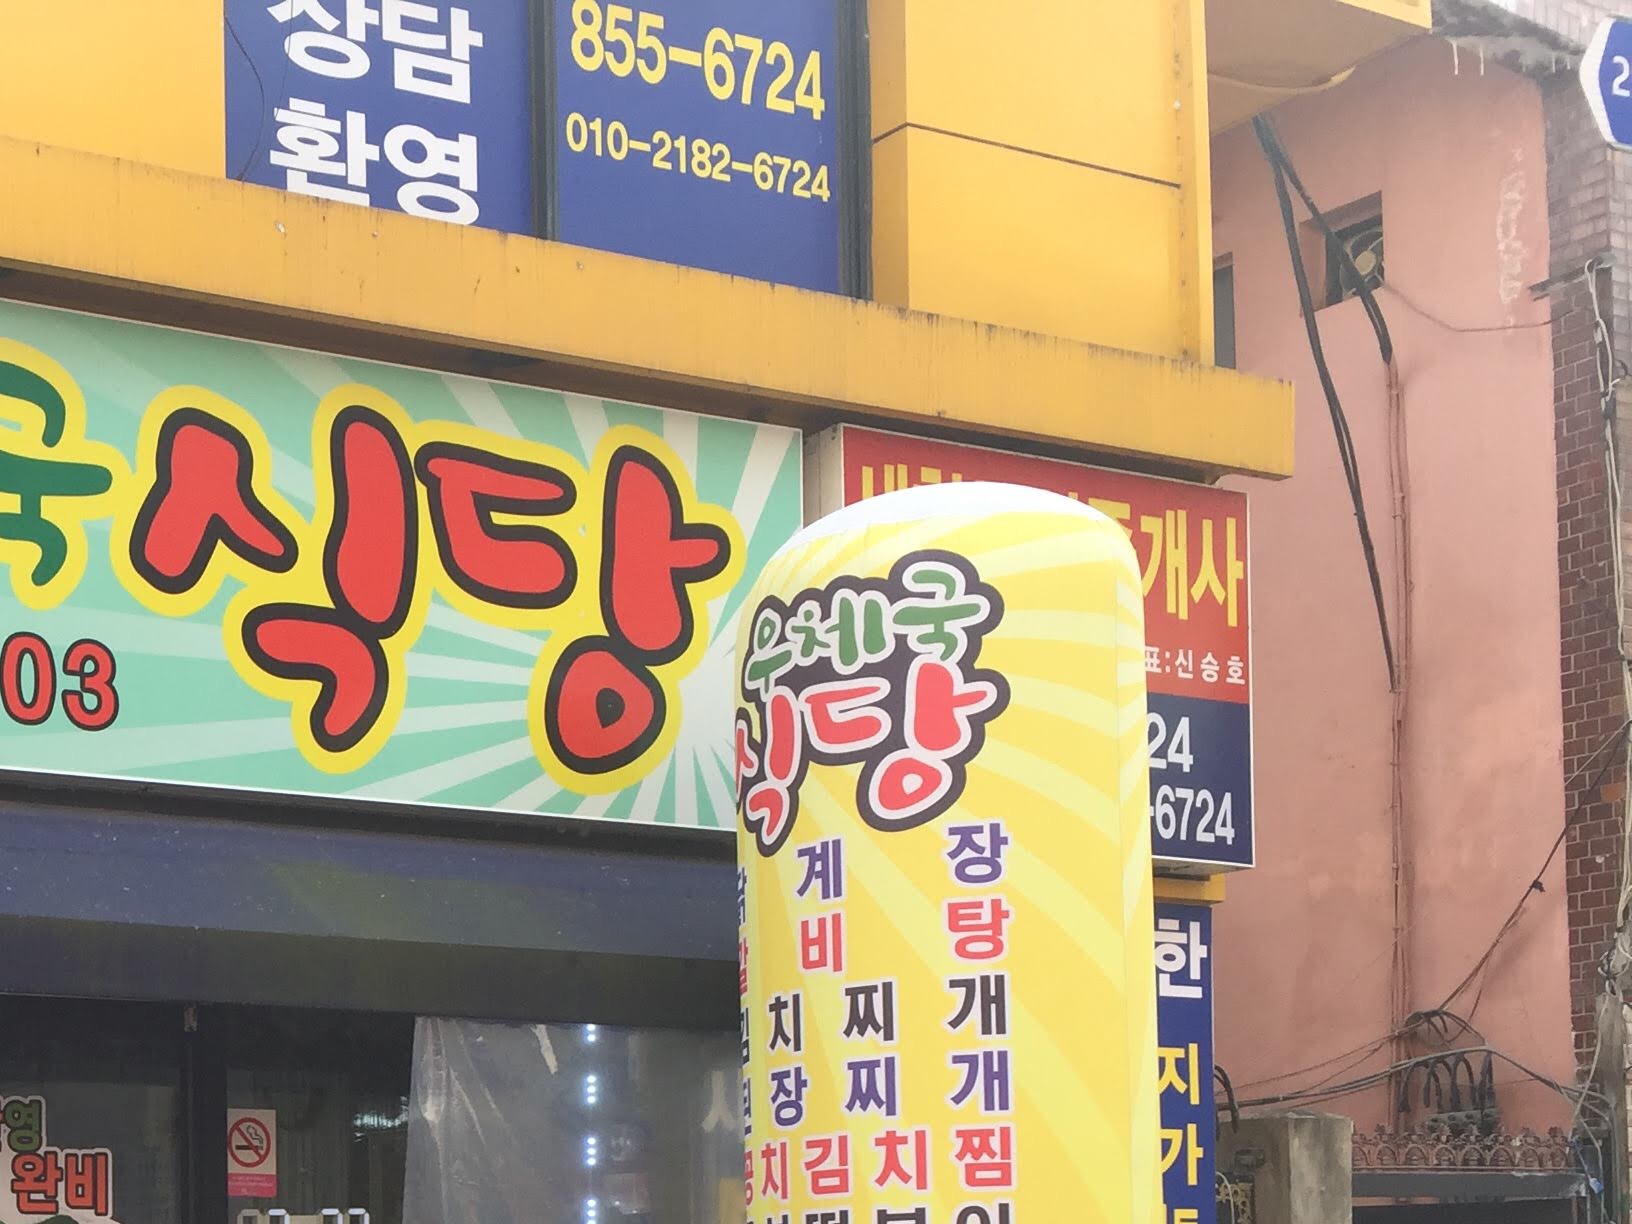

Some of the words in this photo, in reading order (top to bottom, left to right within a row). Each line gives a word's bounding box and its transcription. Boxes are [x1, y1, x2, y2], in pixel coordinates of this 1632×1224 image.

[267, 0, 483, 104] 상담
[570, 0, 825, 120] 855-6724
[270, 97, 480, 226] 환영
[566, 112, 831, 203] 010-2182-6724
[748, 569, 982, 693] 우체국
[10, 1151, 109, 1216] 완비
